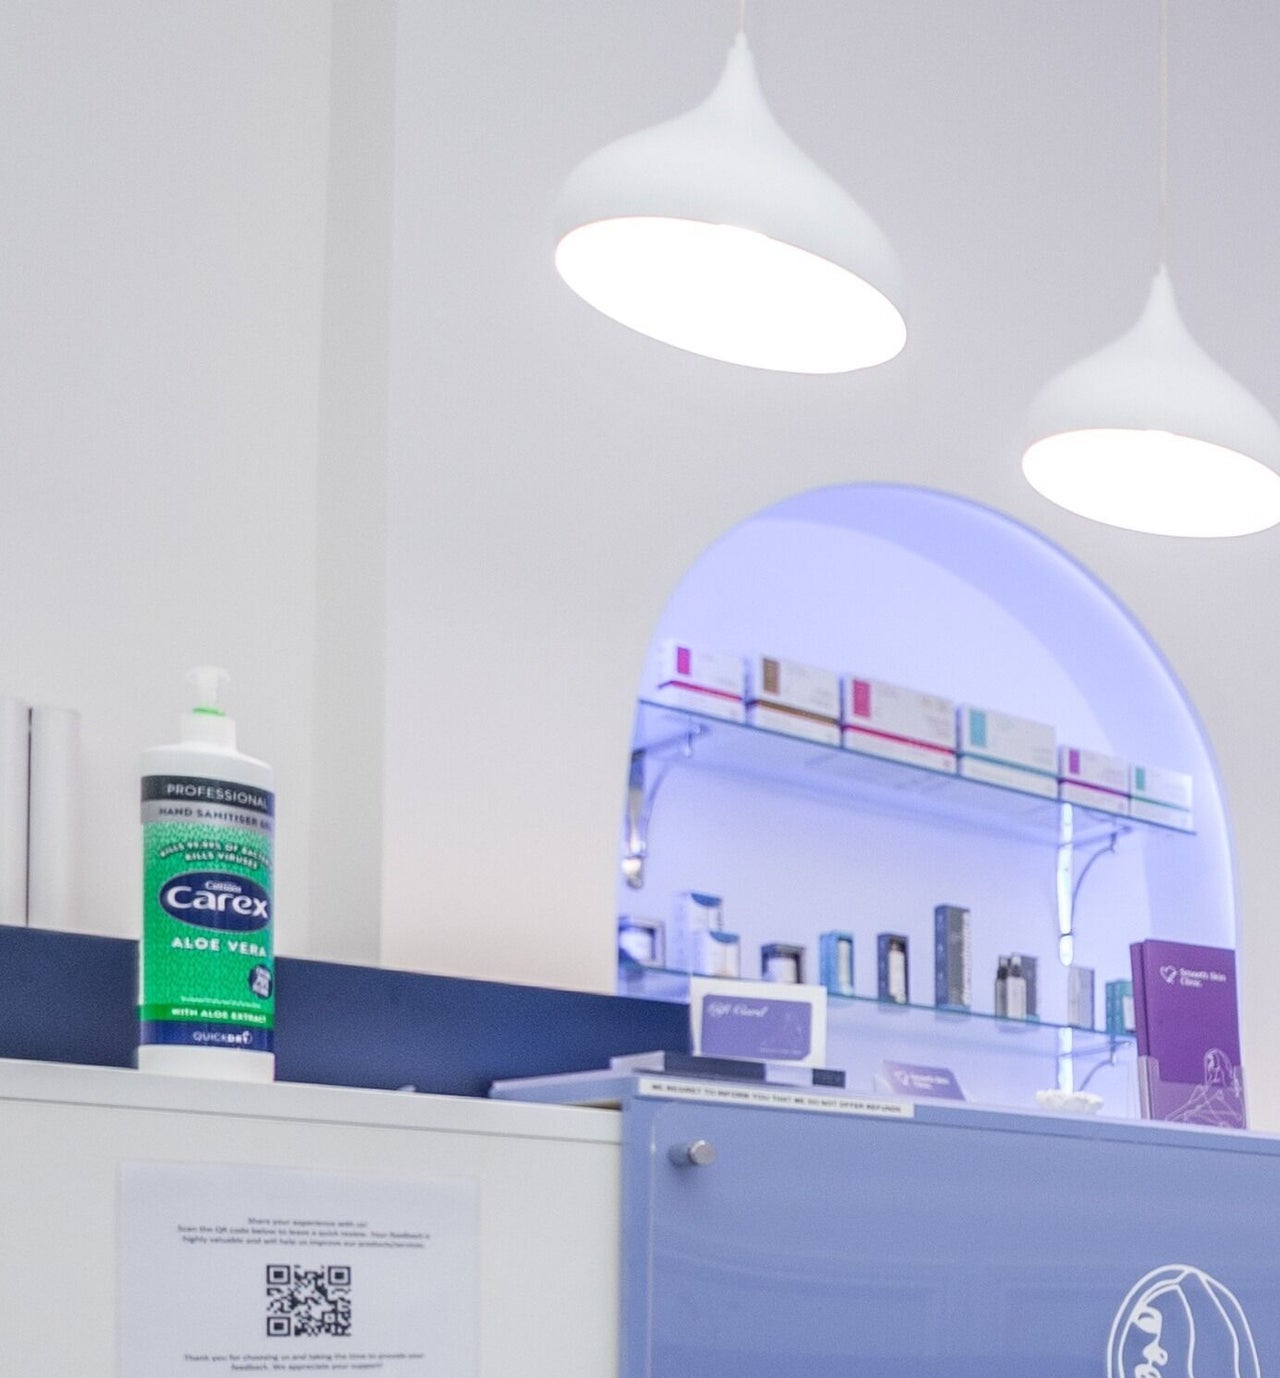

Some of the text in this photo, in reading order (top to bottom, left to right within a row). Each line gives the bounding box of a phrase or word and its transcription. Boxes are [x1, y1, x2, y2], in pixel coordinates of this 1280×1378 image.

[167, 783, 268, 808] PROFESSIONAL
[159, 807, 193, 817] HAND
[196, 808, 257, 825] SANITISER
[166, 885, 269, 919] Carex
[171, 936, 267, 957] ALOE VERA
[171, 1008, 198, 1017] WITH
[200, 1009, 229, 1020] ALOE
